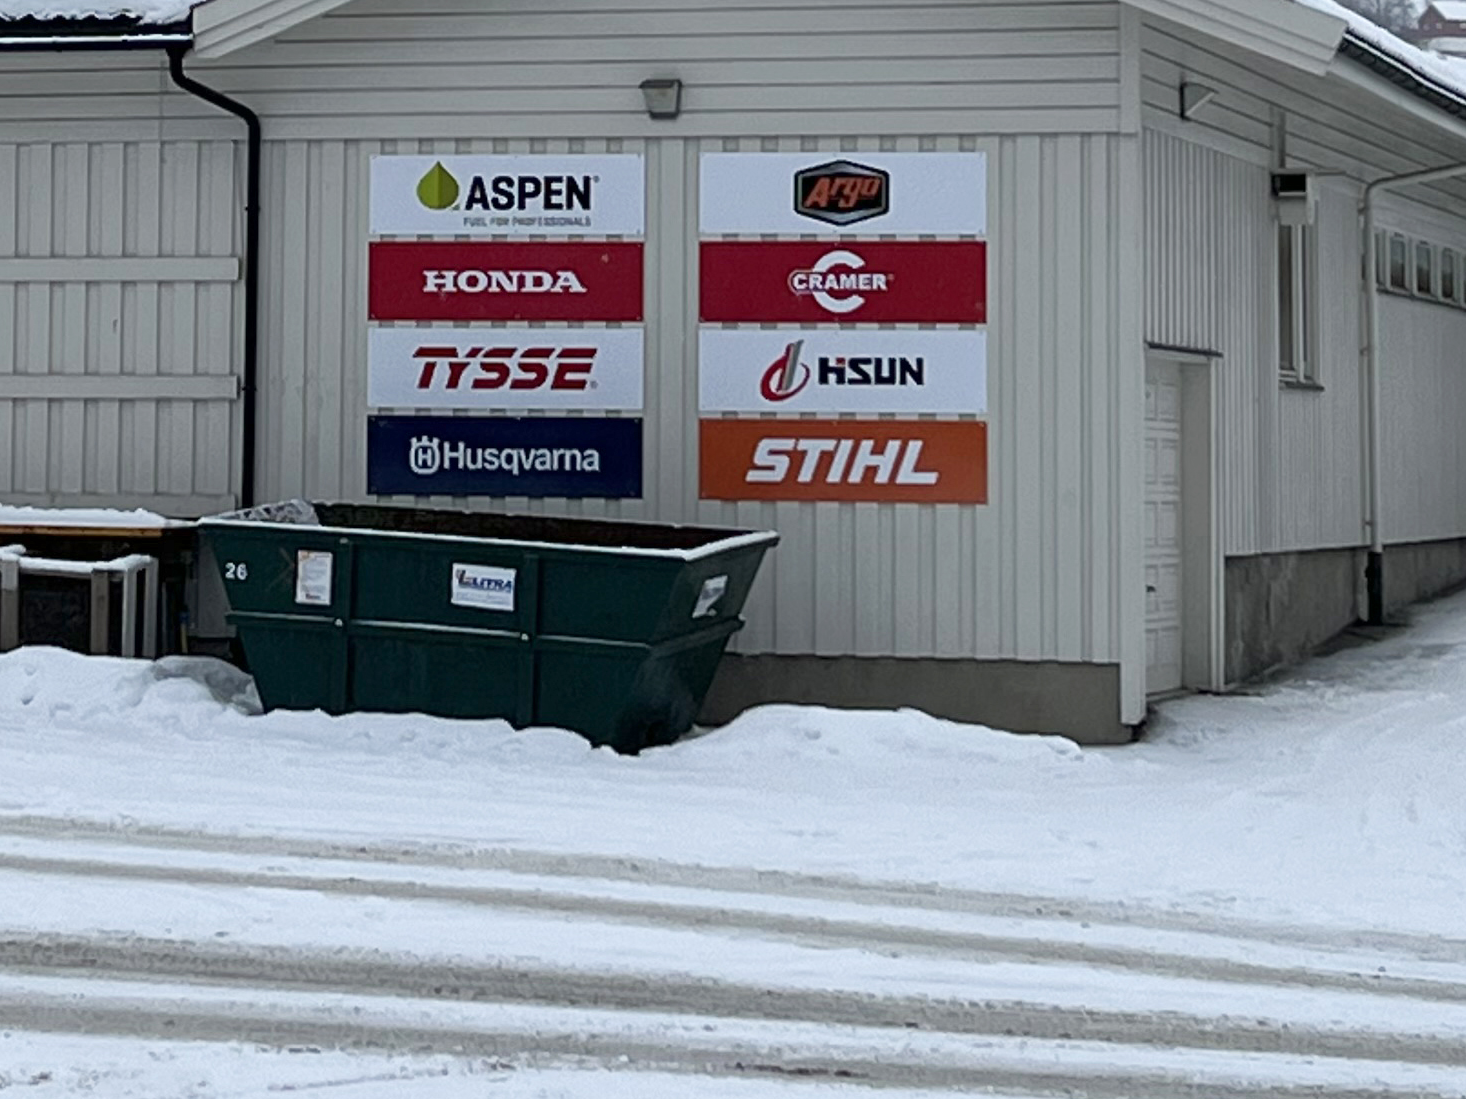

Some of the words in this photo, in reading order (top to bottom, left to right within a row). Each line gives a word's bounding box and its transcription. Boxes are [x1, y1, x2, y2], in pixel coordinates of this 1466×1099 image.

[465, 175, 591, 211] ASPEN
[803, 176, 881, 208] Argo
[463, 217, 487, 227] FUEL
[490, 217, 510, 227] FOR
[512, 216, 592, 227] PROFESSIONALS
[422, 270, 587, 293] HONDA
[792, 273, 888, 291] CRAMER
[412, 347, 598, 390] TYSSE
[443, 441, 600, 476] Husqvarna
[745, 438, 939, 484] STIHL
[225, 562, 248, 580] 26
